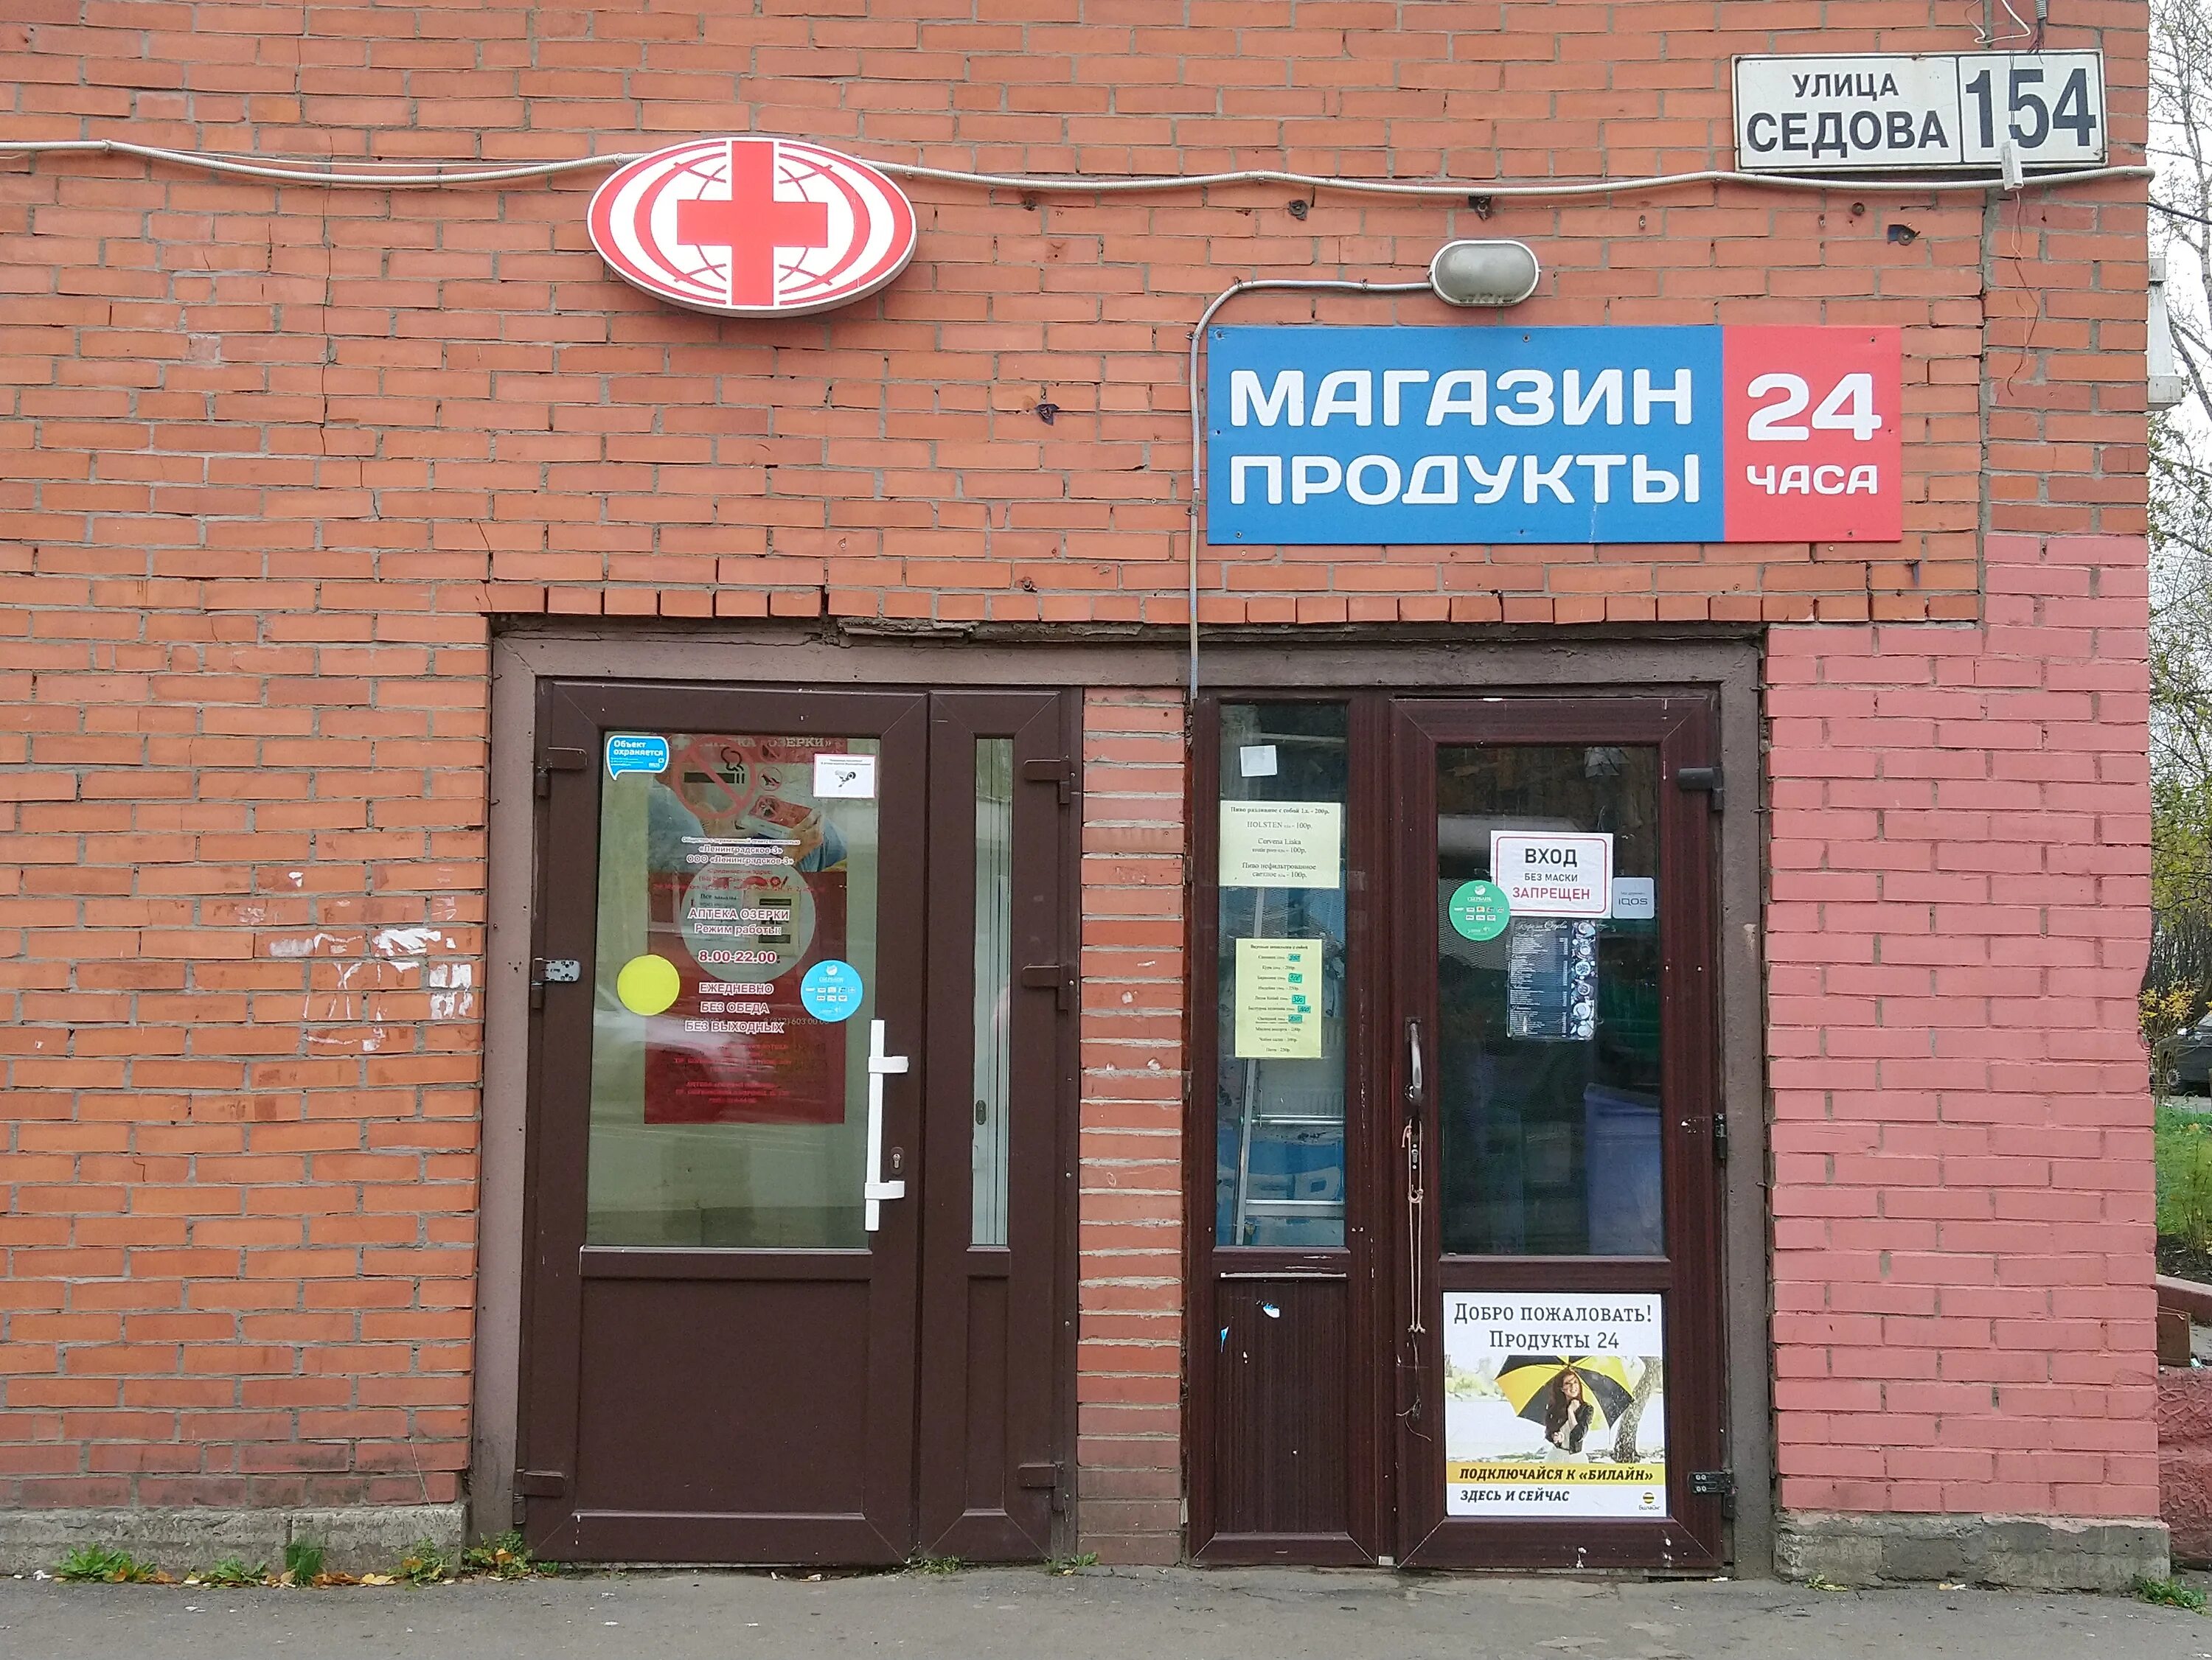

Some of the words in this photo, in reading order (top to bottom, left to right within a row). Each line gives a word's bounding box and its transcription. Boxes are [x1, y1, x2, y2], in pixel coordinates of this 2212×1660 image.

[1792, 73, 1899, 101] УЛИЦА
[1965, 68, 2096, 149] 154
[1747, 111, 1949, 158] СЕДОВА
[1229, 368, 1693, 428] МАГАЗИН
[1746, 372, 1882, 442] 24
[1229, 453, 1700, 506] ПРОДУКТЫ
[1745, 464, 1879, 495] ЧАСА
[1296, 822, 1312, 830] 100р.
[686, 854, 709, 863] ООО
[709, 855, 794, 865] «Ленинградское-3»
[1525, 848, 1578, 868] ВХОД
[1524, 873, 1542, 881] БЕЗ
[1545, 873, 1578, 882] МАСКИ
[1512, 887, 1590, 901] ЗАПРЕЩЕН
[1618, 898, 1648, 906] IQOS
[688, 907, 738, 919] АПТЕКА
[740, 909, 790, 920] ОЗЕРКИ
[695, 924, 732, 934] Режим
[734, 924, 782, 936] работы:
[698, 951, 776, 963] 8.00-22.00
[698, 982, 774, 995] ЕЖЕДНЕВНО
[700, 1002, 725, 1013] БЕЗ
[726, 1002, 770, 1016] ОБЕДА
[685, 1021, 709, 1032] БЕЗ
[711, 1021, 785, 1033] ВЫХОДНЫХ
[1597, 1332, 1619, 1349] 24
[1459, 1466, 1562, 1482] ПОДКЛЮЧАЙСЯ
[1565, 1469, 1576, 1480] К
[1579, 1467, 1654, 1482] «БИЛАЙН»
[1460, 1490, 1501, 1502] ЗДЕСЬ
[1505, 1490, 1515, 1501] И
[1517, 1488, 1570, 1502] СЕЙЧАС
